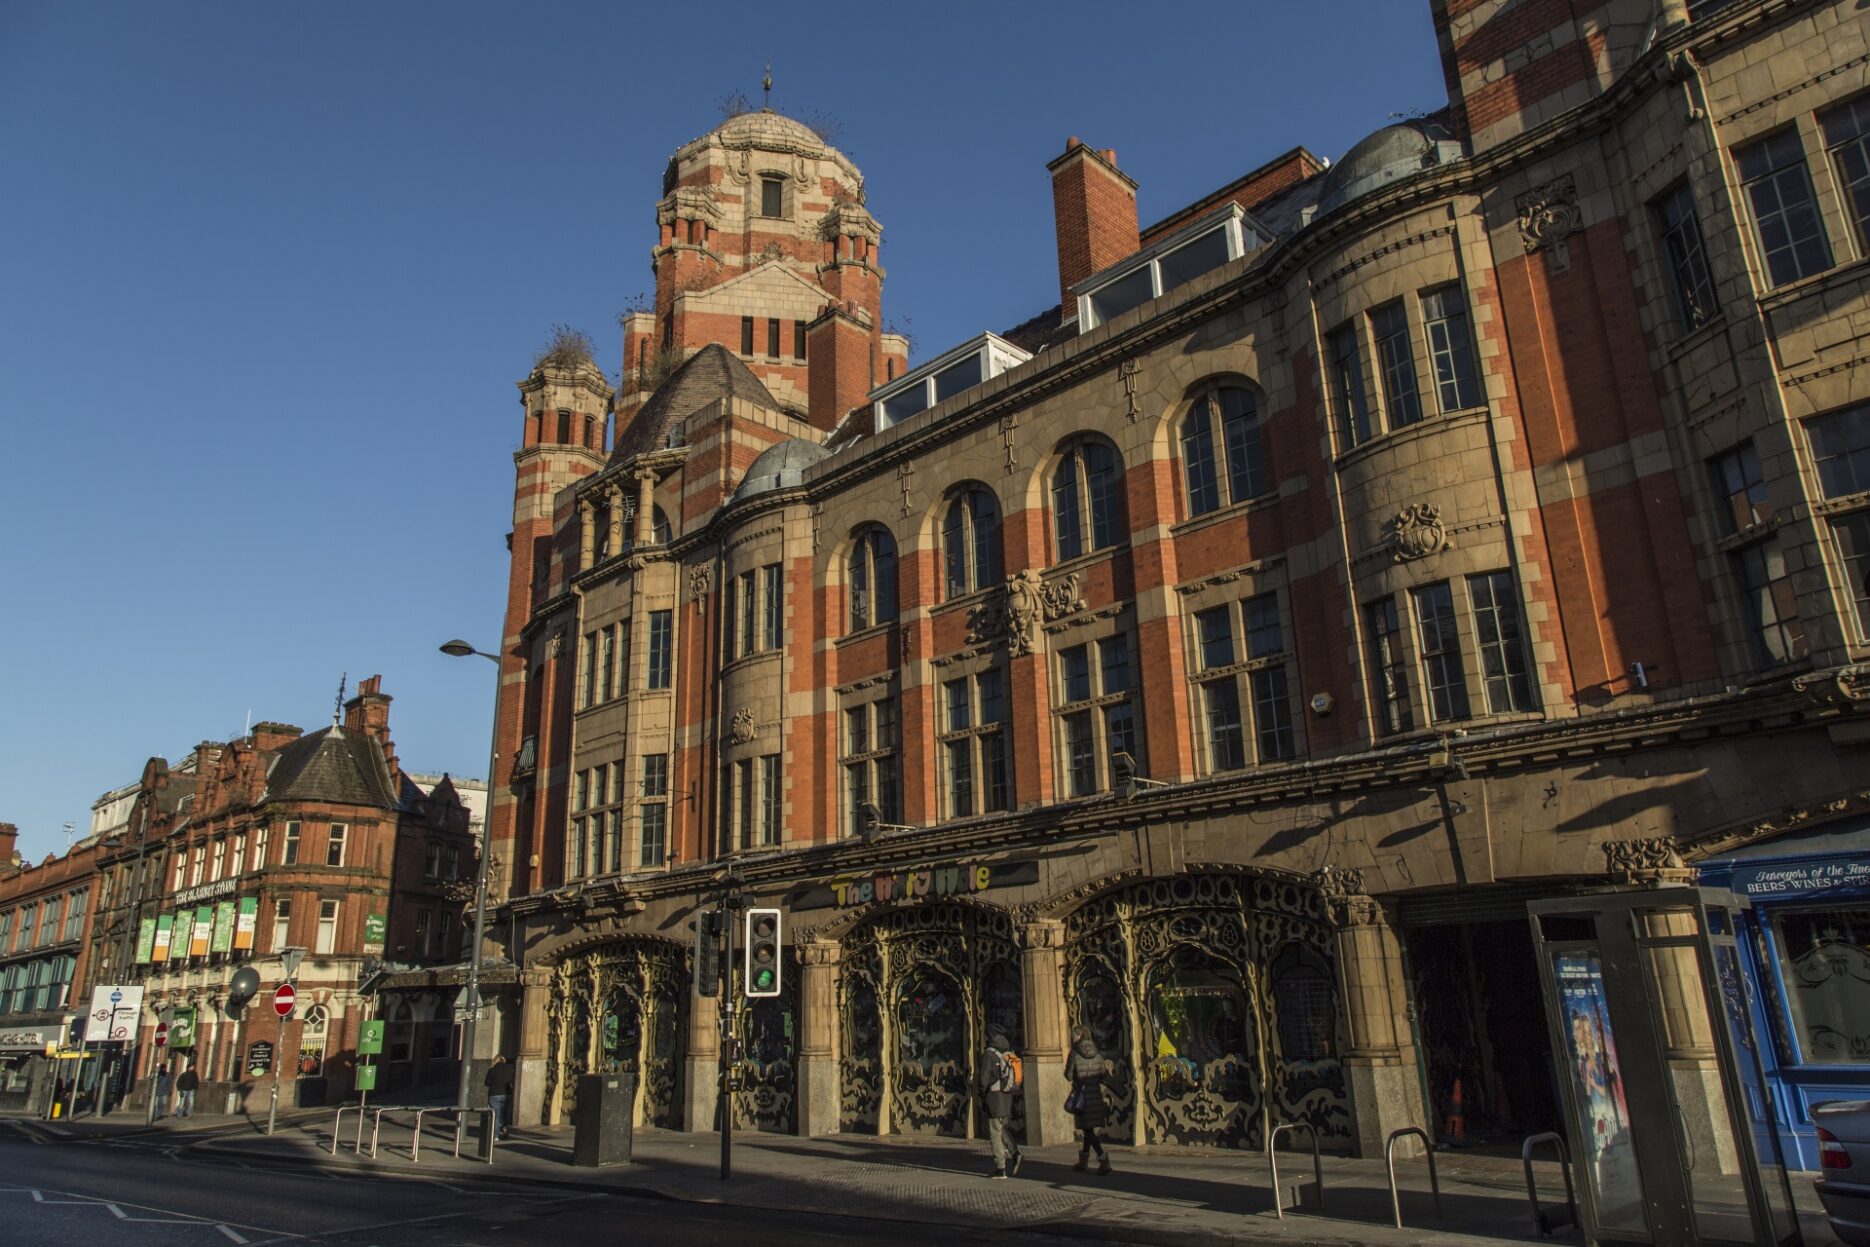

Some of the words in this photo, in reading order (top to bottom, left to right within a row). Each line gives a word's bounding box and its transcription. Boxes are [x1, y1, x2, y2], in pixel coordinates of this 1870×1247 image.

[1811, 866, 1824, 879] of
[1827, 865, 1844, 876] the
[831, 873, 873, 906] The
[1747, 881, 1786, 893] BEERS
[1790, 878, 1831, 889] WINES
